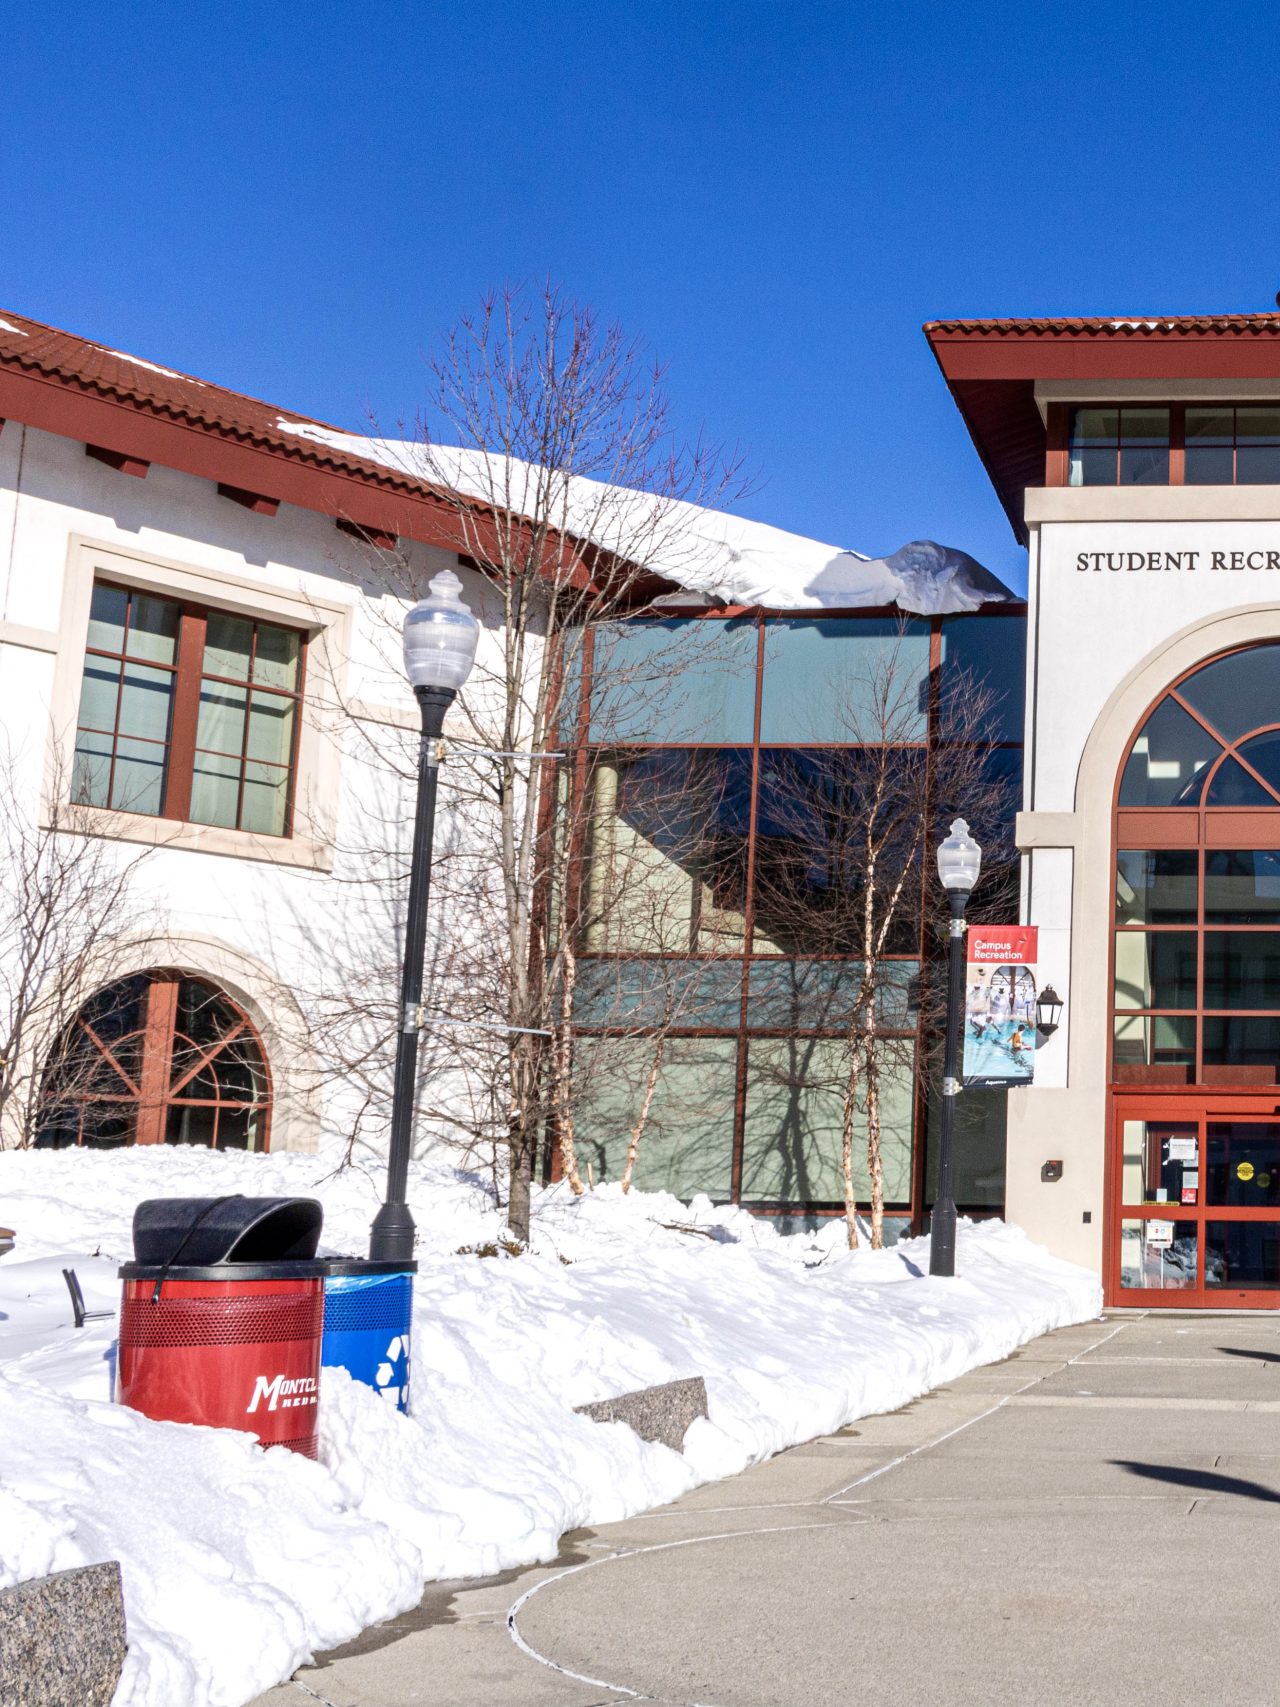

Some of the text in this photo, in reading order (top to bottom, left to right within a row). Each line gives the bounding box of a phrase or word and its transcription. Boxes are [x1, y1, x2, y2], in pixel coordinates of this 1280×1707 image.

[1076, 551, 1200, 572] STUDENT
[974, 940, 1011, 951] Campus
[974, 950, 1022, 959] Recreation
